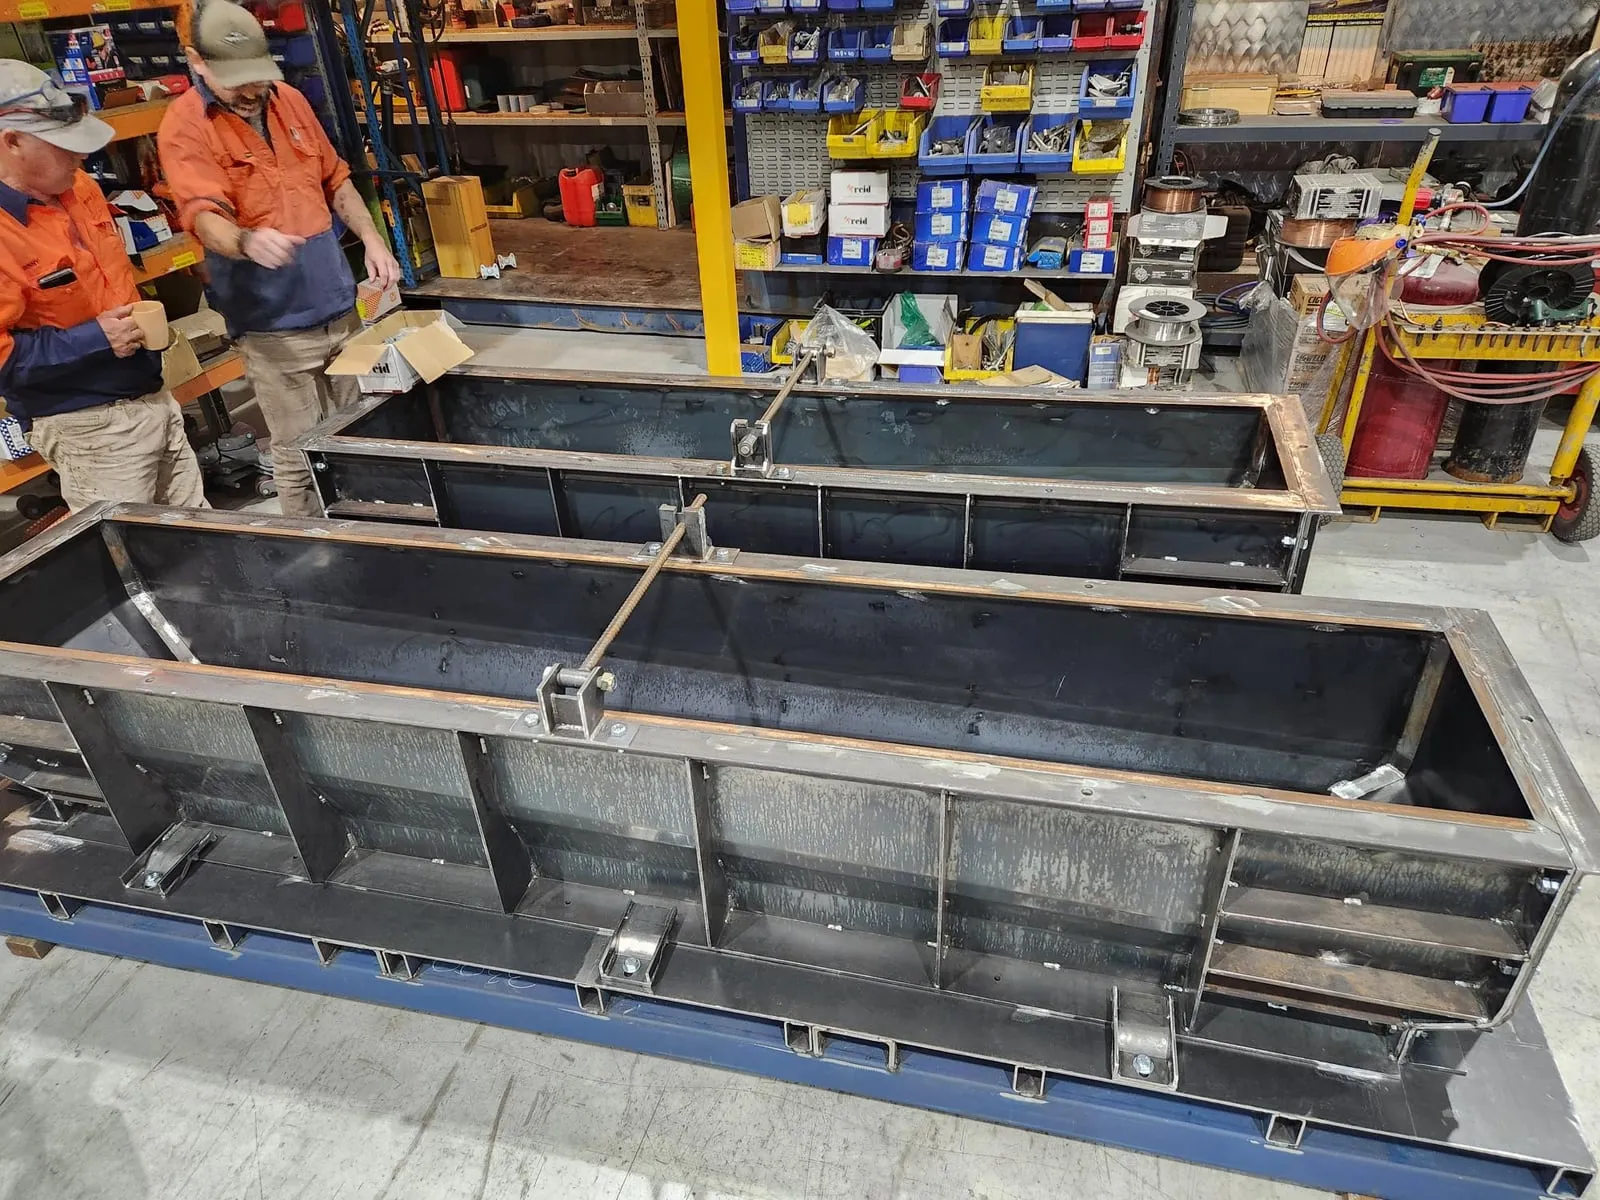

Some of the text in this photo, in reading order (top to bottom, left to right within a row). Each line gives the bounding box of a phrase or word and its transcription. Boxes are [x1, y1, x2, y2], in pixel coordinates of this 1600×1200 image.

[854, 185, 871, 193] reid
[851, 217, 868, 225] reid
[372, 363, 391, 374] eid
